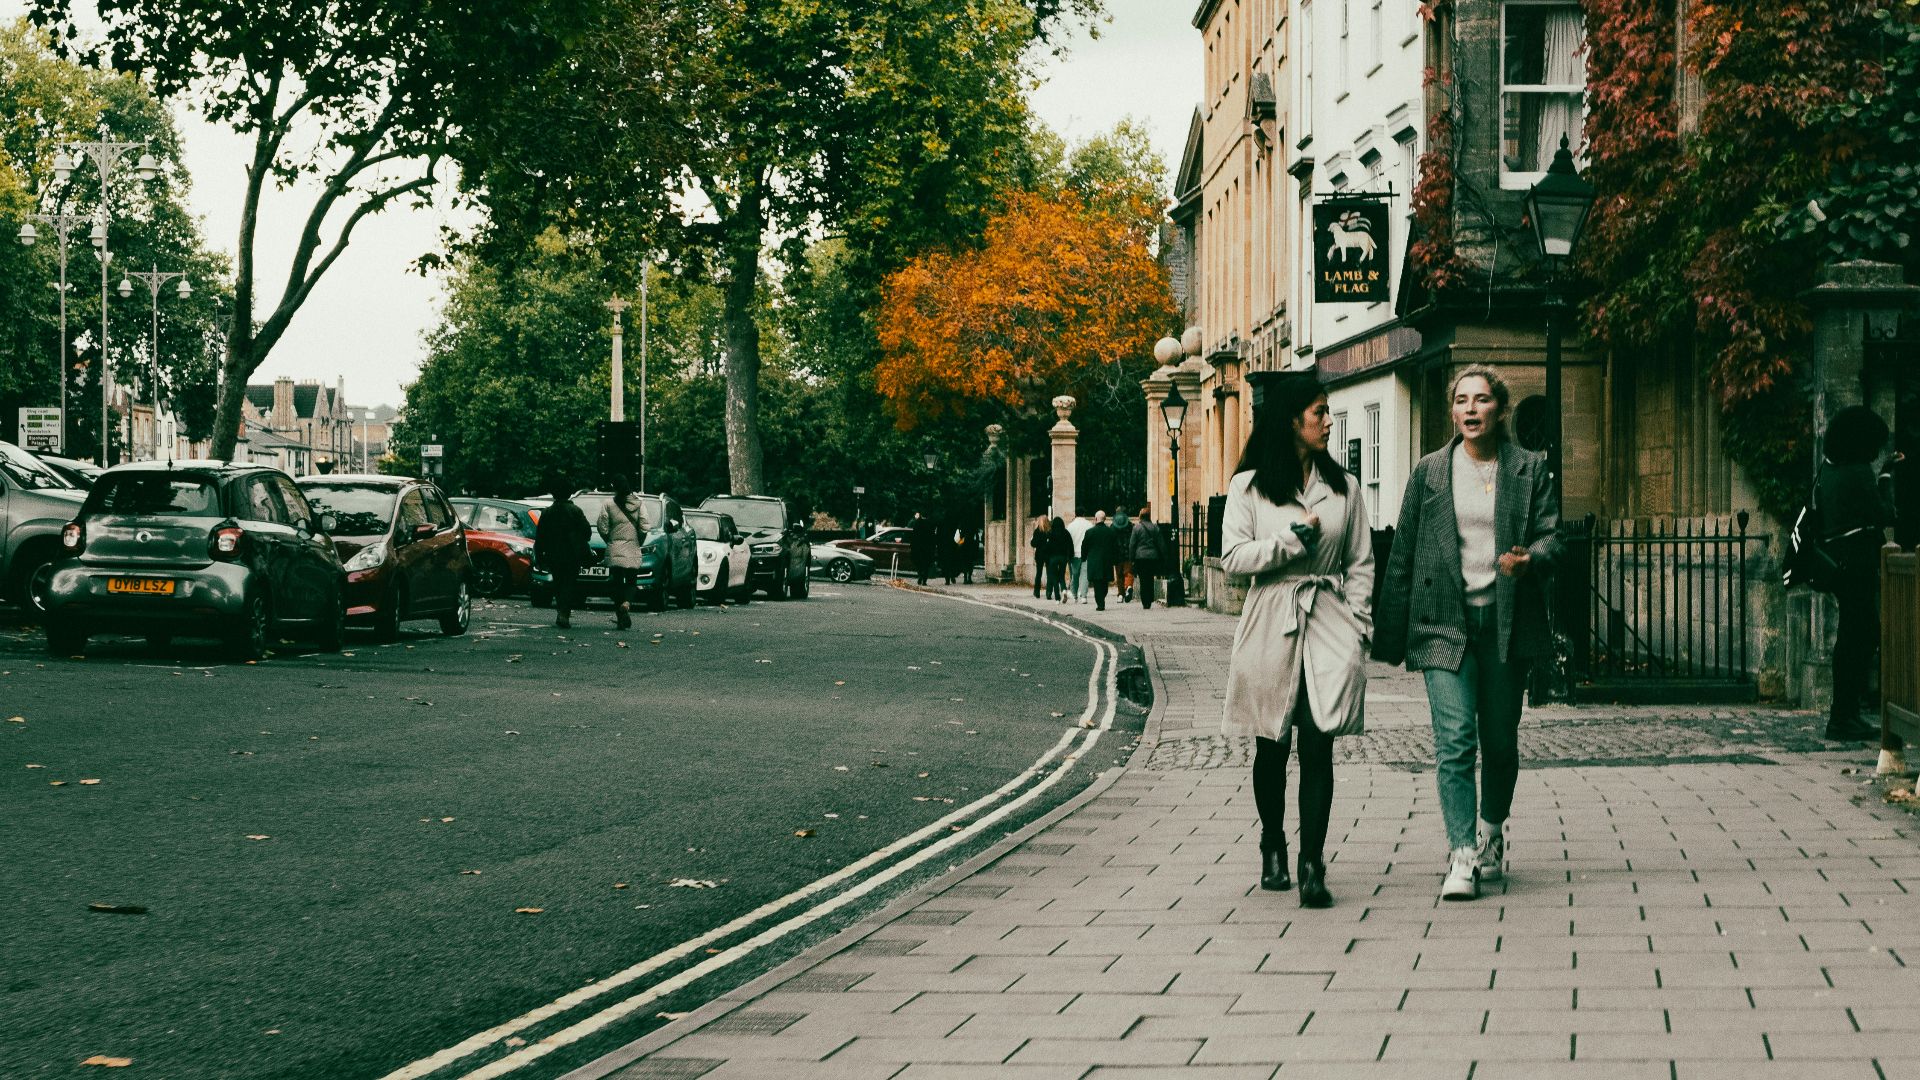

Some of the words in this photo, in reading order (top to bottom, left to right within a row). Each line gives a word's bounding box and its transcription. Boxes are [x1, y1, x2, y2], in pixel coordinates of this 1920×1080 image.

[1324, 271, 1363, 281] LAMB
[1368, 270, 1380, 281] &
[1335, 283, 1369, 293] FLAG
[143, 580, 168, 592] LSZ
